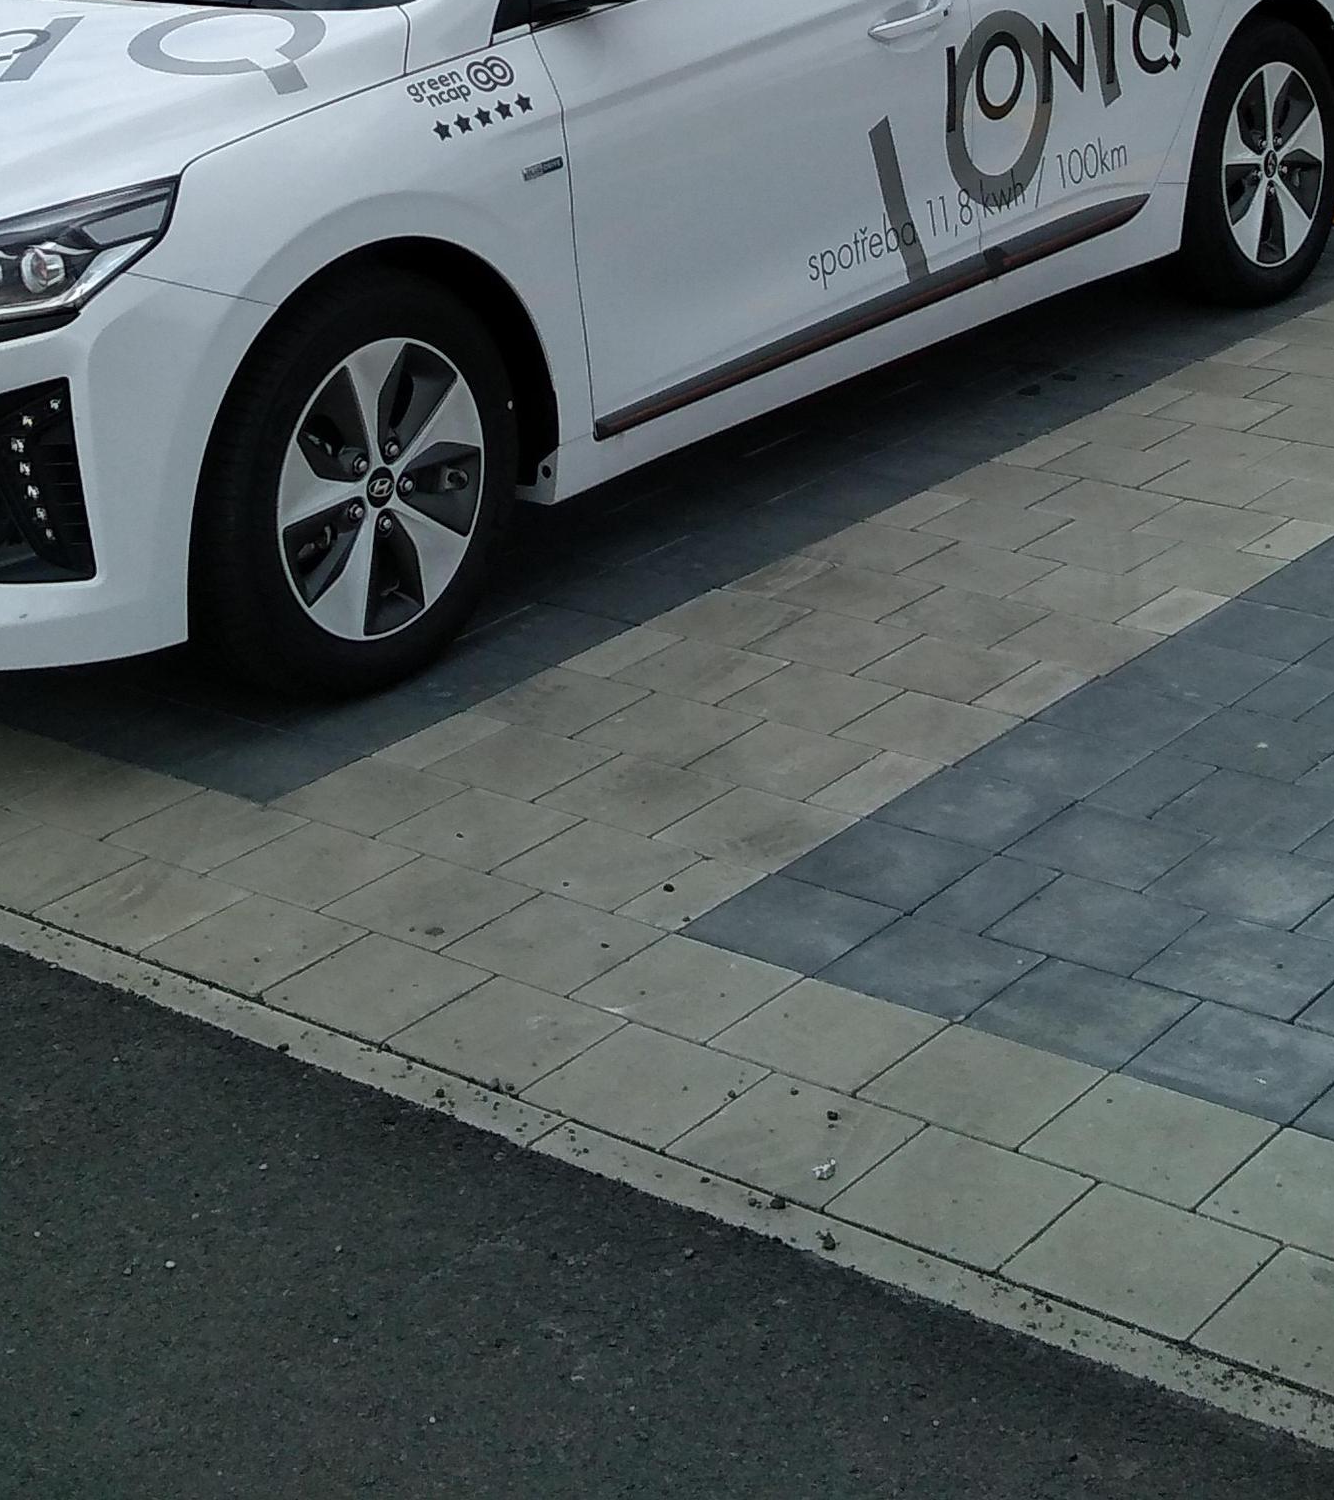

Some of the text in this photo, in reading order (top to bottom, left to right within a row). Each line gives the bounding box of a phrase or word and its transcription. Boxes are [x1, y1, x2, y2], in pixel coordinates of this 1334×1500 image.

[406, 70, 464, 104] green
[426, 83, 472, 108] ncap
[808, 212, 918, 290] spotřeba
[927, 188, 974, 238] 11,8
[1057, 137, 1129, 190] 100km
